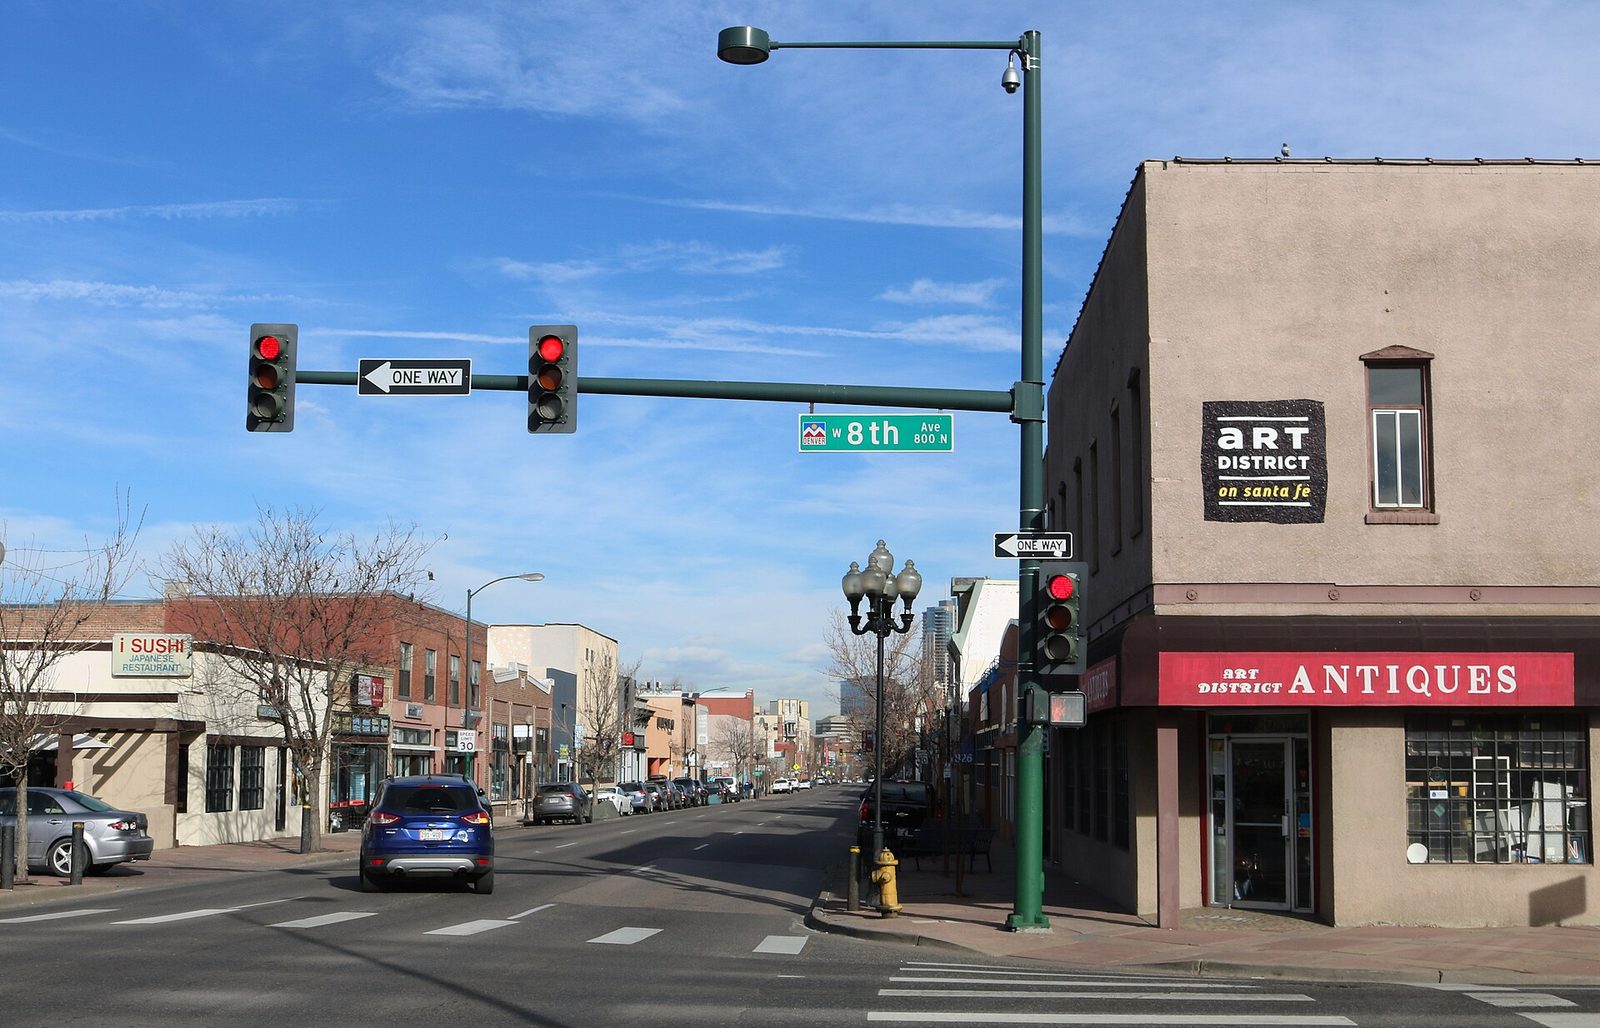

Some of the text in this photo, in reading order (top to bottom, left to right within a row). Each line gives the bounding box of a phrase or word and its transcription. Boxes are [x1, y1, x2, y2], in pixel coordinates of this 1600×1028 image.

[392, 370, 458, 384] ONE WAY
[921, 422, 941, 432] Ave
[832, 421, 899, 446] W 8th
[914, 434, 948, 444] 800 N
[803, 437, 826, 445] DENVER
[1217, 455, 1310, 470] DISTRICT
[1218, 483, 1311, 500] on santa fe
[1017, 540, 1063, 551] ONE WAY
[120, 637, 184, 654] i SUSHI
[129, 655, 174, 663] JAPANESE
[122, 663, 181, 672] RESTAURANT
[1288, 664, 1518, 698] ANTIQUES
[1197, 682, 1283, 694] DISTRICT
[459, 742, 474, 751] 30
